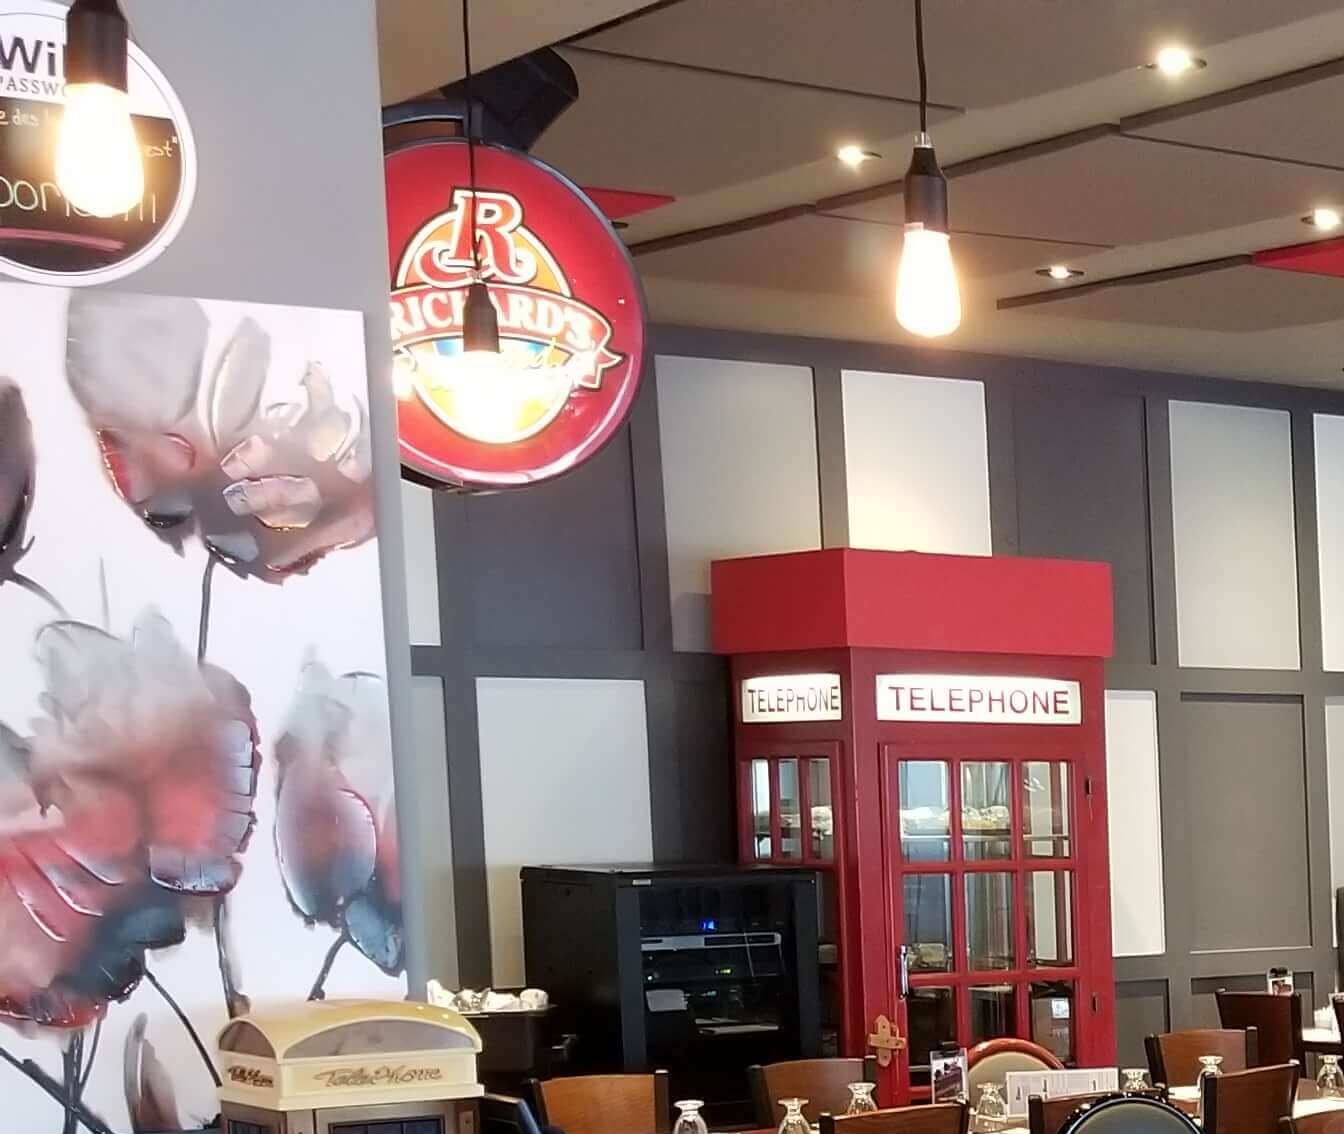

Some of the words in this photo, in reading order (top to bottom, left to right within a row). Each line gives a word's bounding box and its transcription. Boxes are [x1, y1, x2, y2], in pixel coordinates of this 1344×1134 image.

[0, 36, 66, 77] Wi
[0, 77, 67, 97] ASSW
[747, 685, 840, 714] TELEPHONE
[887, 685, 1071, 715] TELEPHONE
